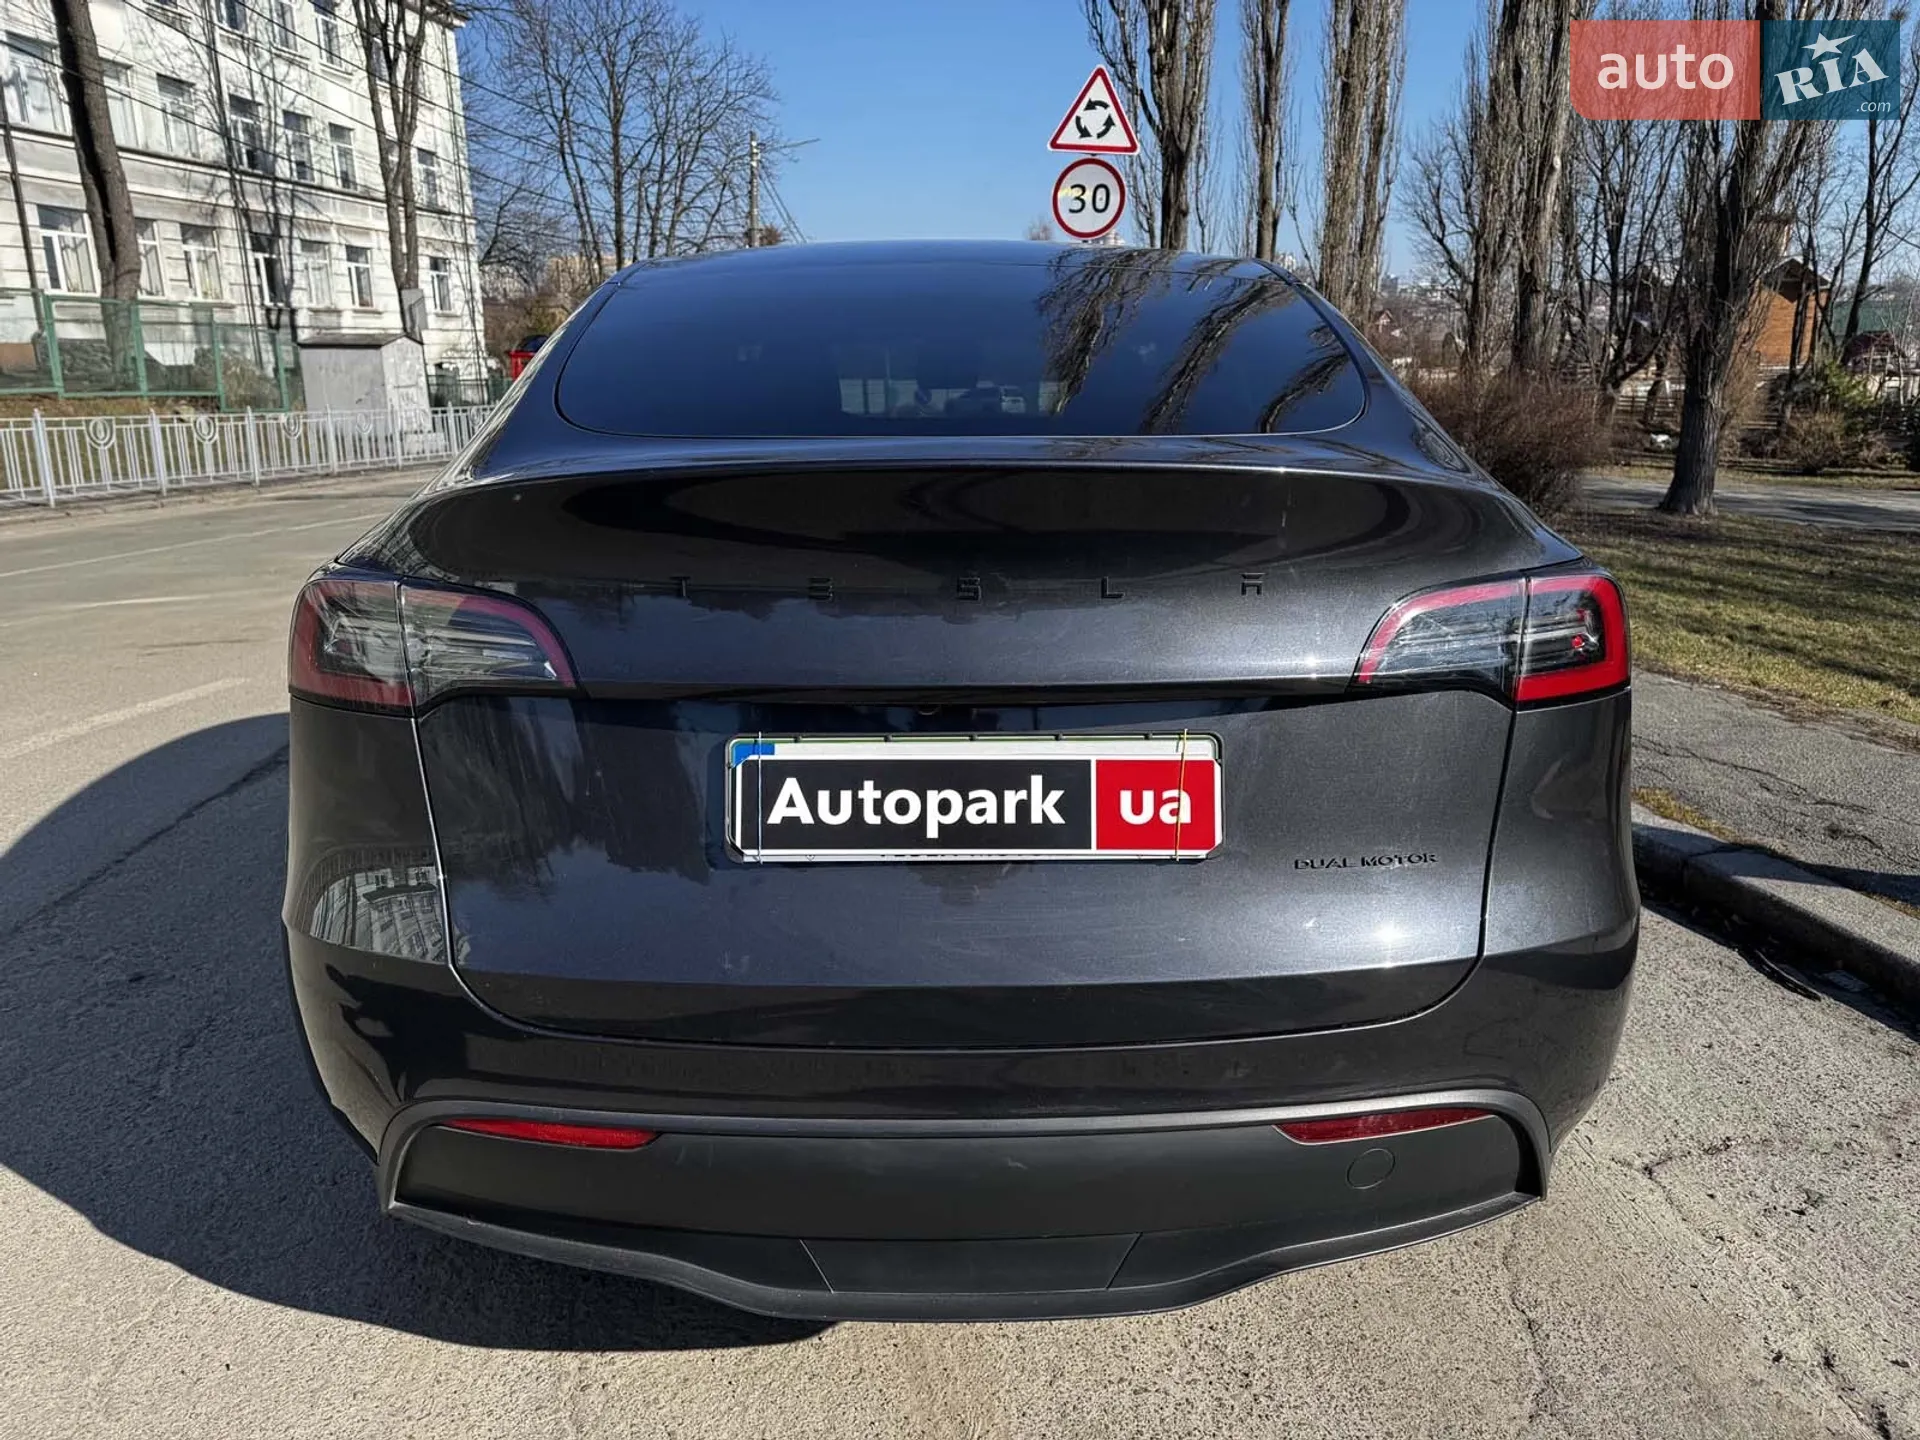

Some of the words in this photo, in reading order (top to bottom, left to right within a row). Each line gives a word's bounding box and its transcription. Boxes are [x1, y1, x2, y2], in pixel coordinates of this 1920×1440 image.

[1068, 183, 1111, 214] 30
[669, 573, 1266, 603] TESLA
[766, 774, 1066, 838] Autopark
[1119, 789, 1192, 825] ua
[1294, 855, 1357, 870] DUAL
[1360, 852, 1439, 868] MOTOR
